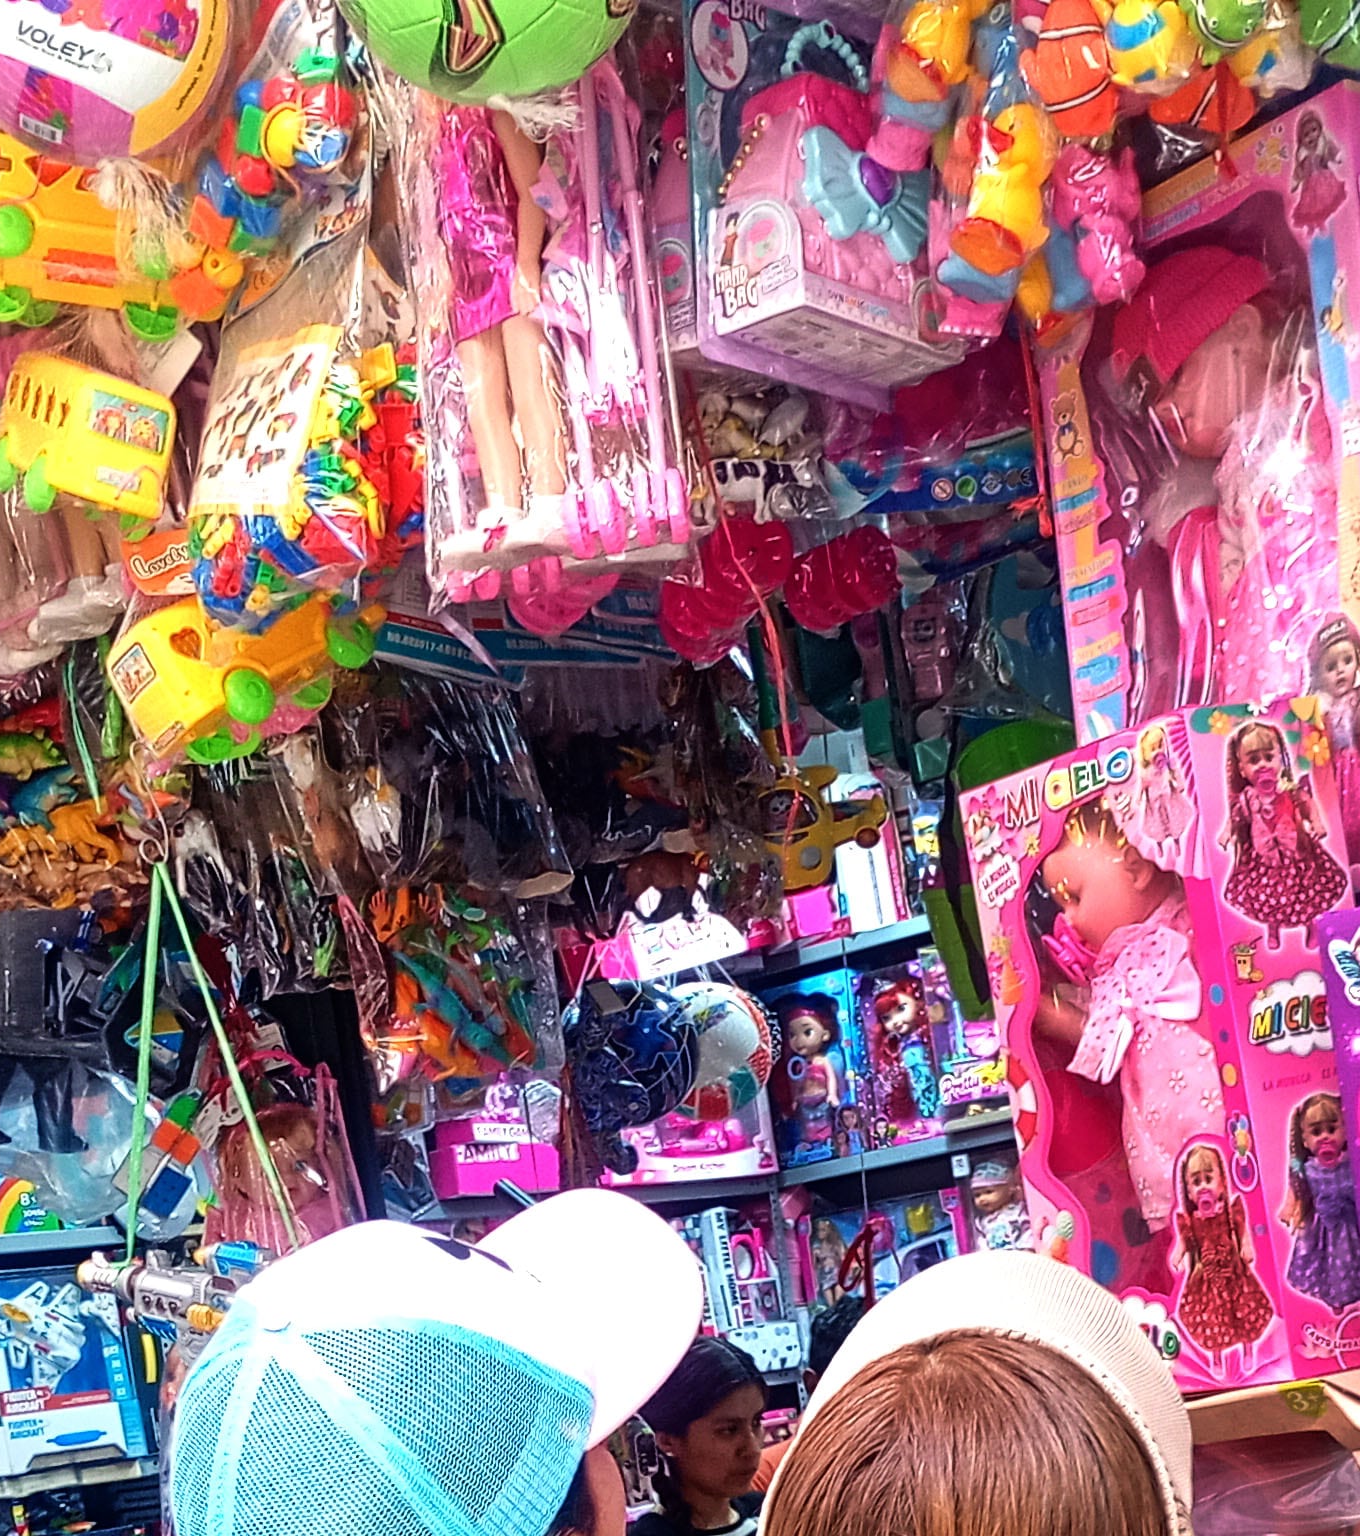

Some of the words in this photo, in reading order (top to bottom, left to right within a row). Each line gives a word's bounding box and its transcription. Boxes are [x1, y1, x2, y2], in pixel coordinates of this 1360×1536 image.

[17, 19, 95, 62] VOLEY
[715, 263, 748, 296] HAND
[723, 275, 760, 318] BAG
[1005, 777, 1039, 827] MI
[1252, 1000, 1283, 1041] MI
[714, 1211, 726, 1231] MY
[718, 1234, 733, 1270] LITTLE
[725, 1273, 740, 1307] HOME
